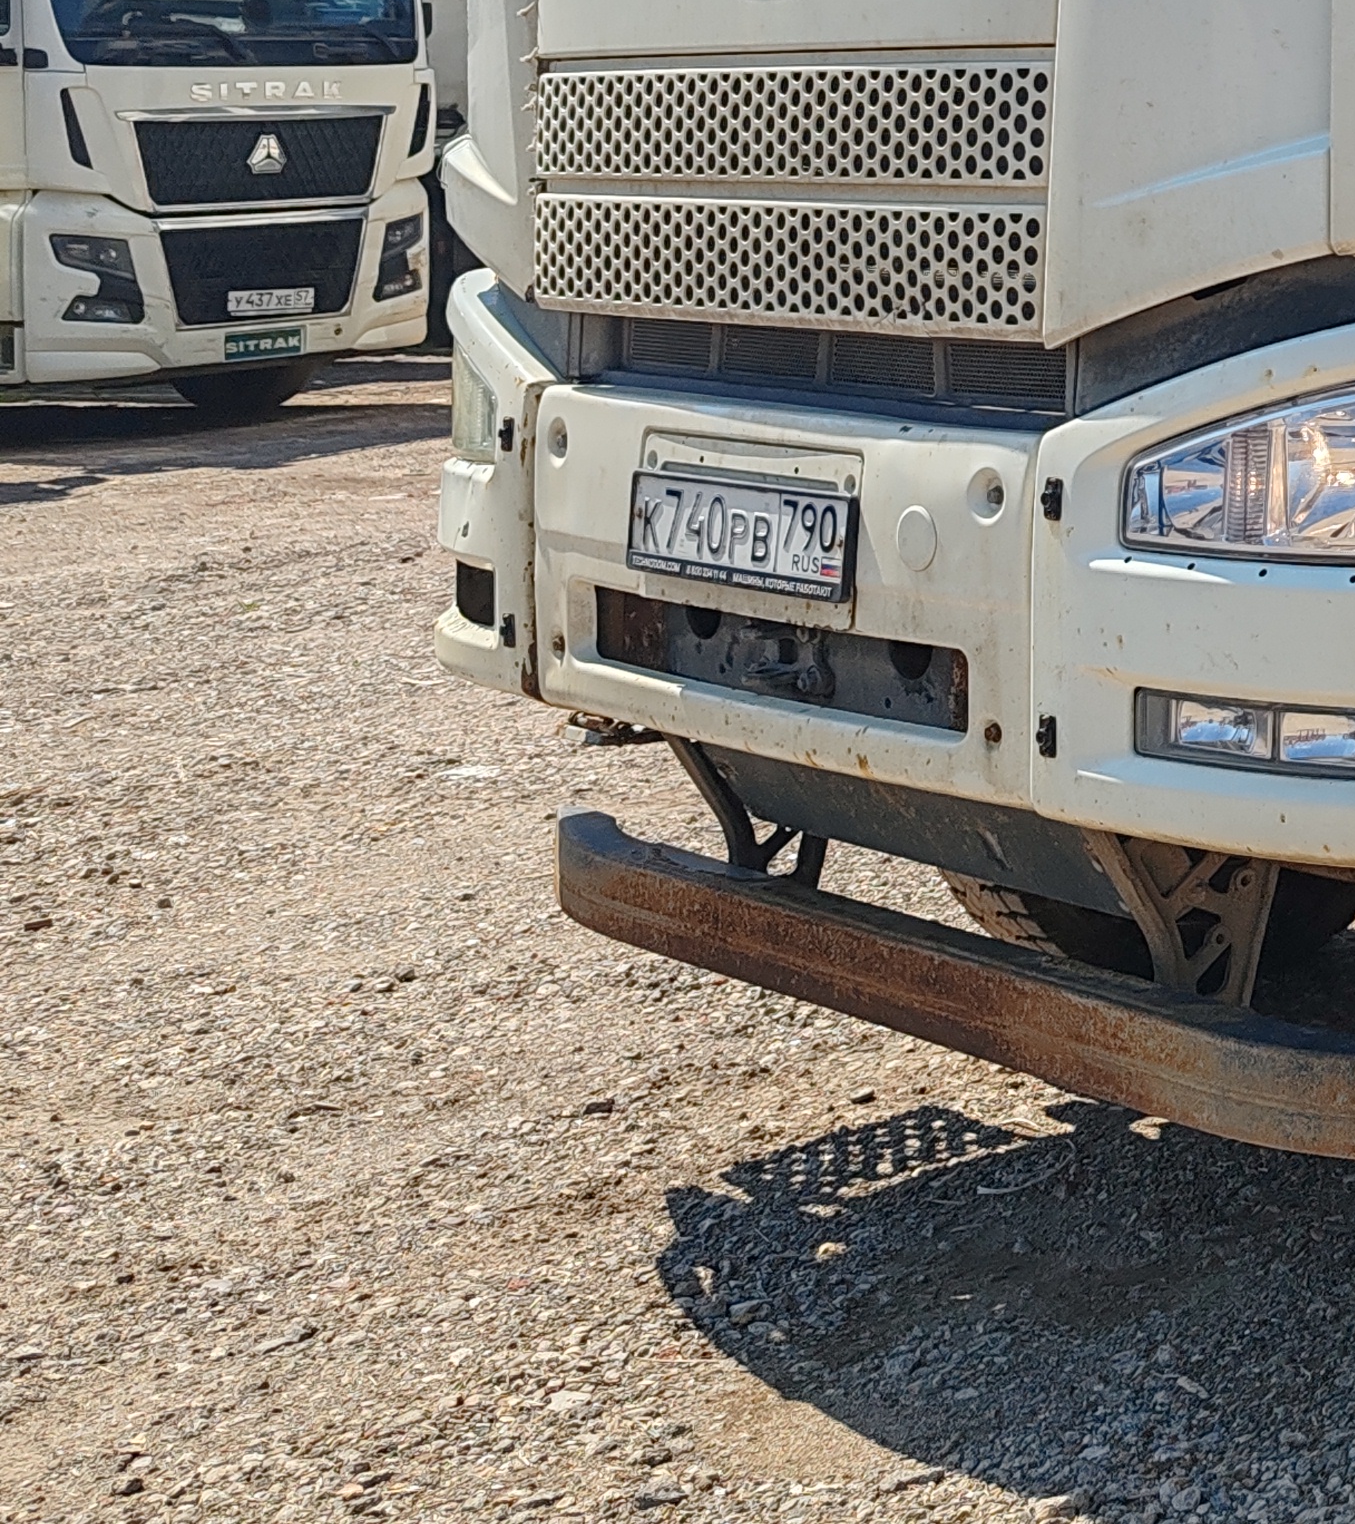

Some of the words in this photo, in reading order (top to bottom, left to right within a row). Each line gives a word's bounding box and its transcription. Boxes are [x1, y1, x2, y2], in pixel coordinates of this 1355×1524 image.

[190, 81, 343, 102] SITRAK
[225, 336, 301, 353] SITRAK
[782, 499, 838, 553] 790
[791, 553, 820, 574] RUS
